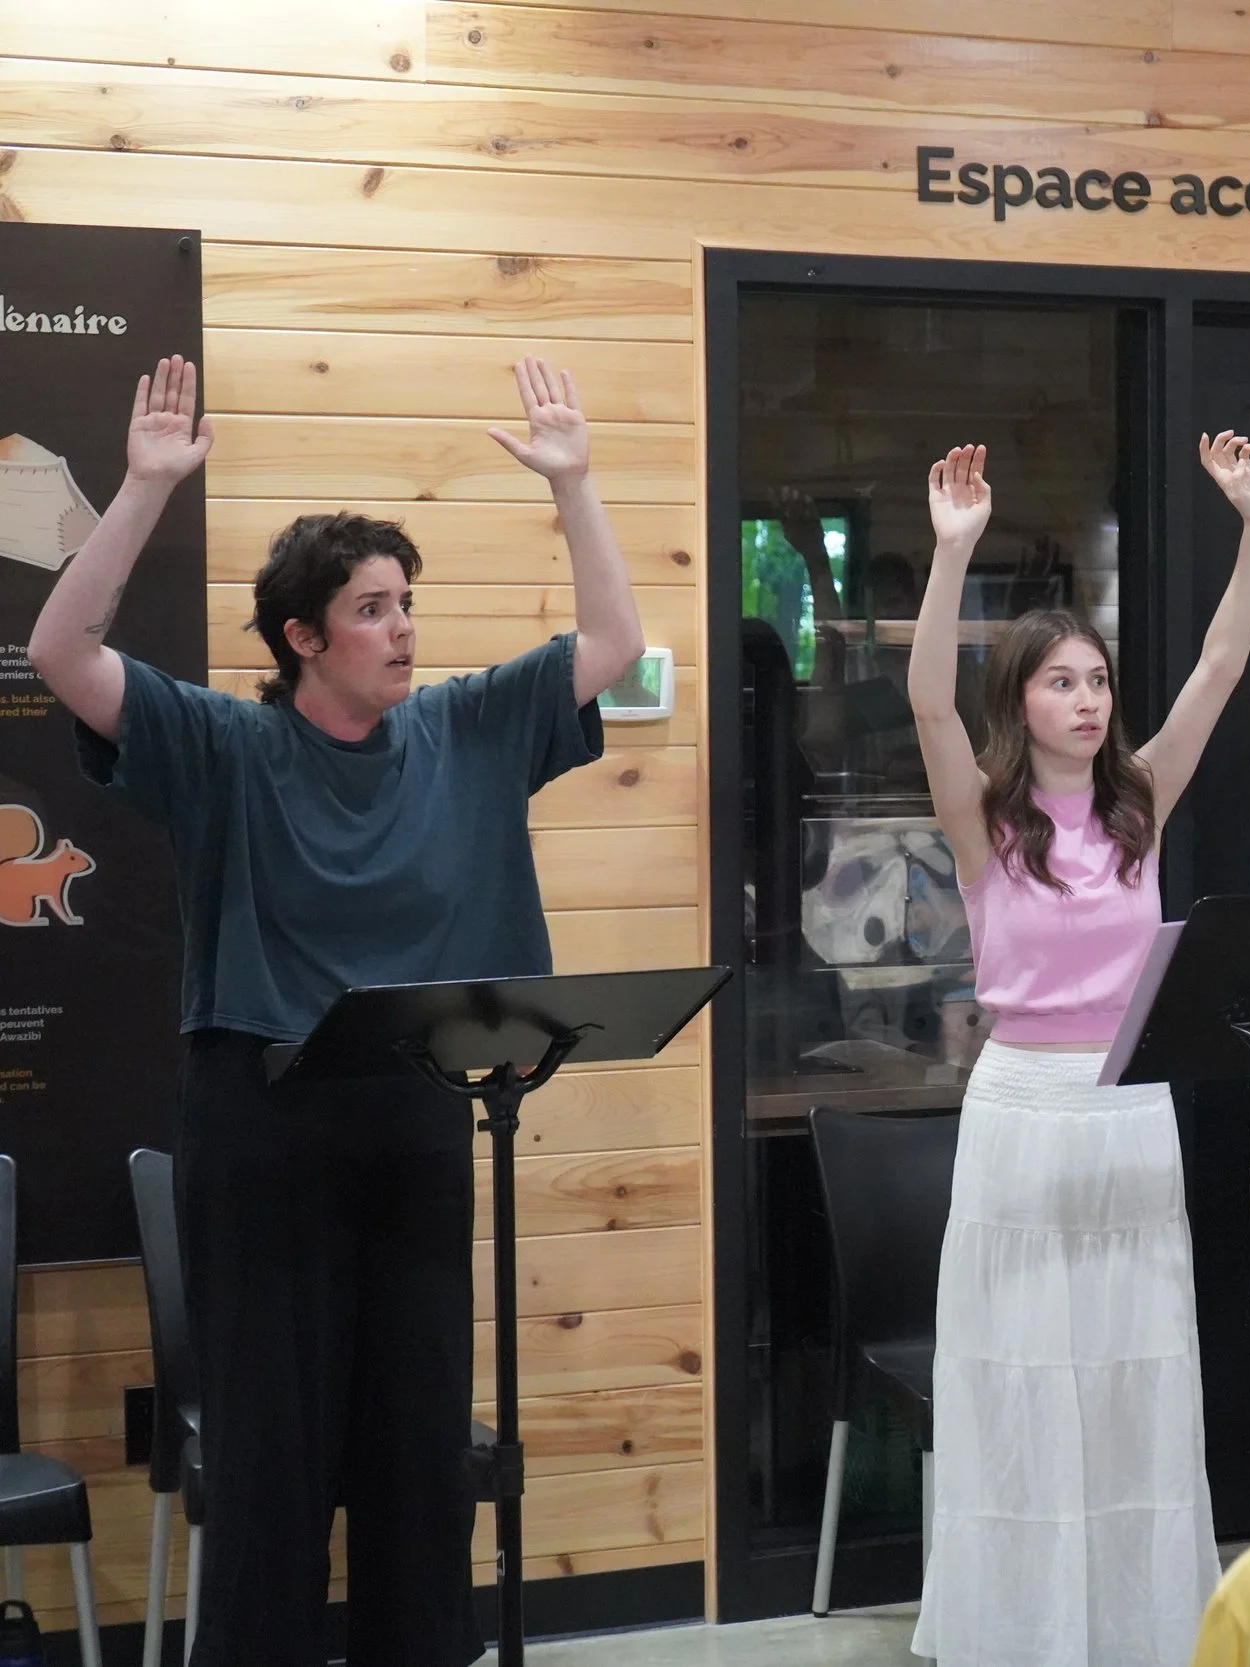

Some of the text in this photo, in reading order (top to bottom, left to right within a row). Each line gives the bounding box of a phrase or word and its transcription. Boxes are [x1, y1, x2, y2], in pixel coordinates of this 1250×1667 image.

[916, 145, 1151, 221] Espace
[8, 644, 26, 654] Pre
[11, 694, 31, 704] but
[33, 694, 56, 704] also
[22, 707, 48, 716] their
[9, 1005, 63, 1016] tentatives
[0, 1019, 44, 1031] peuvent
